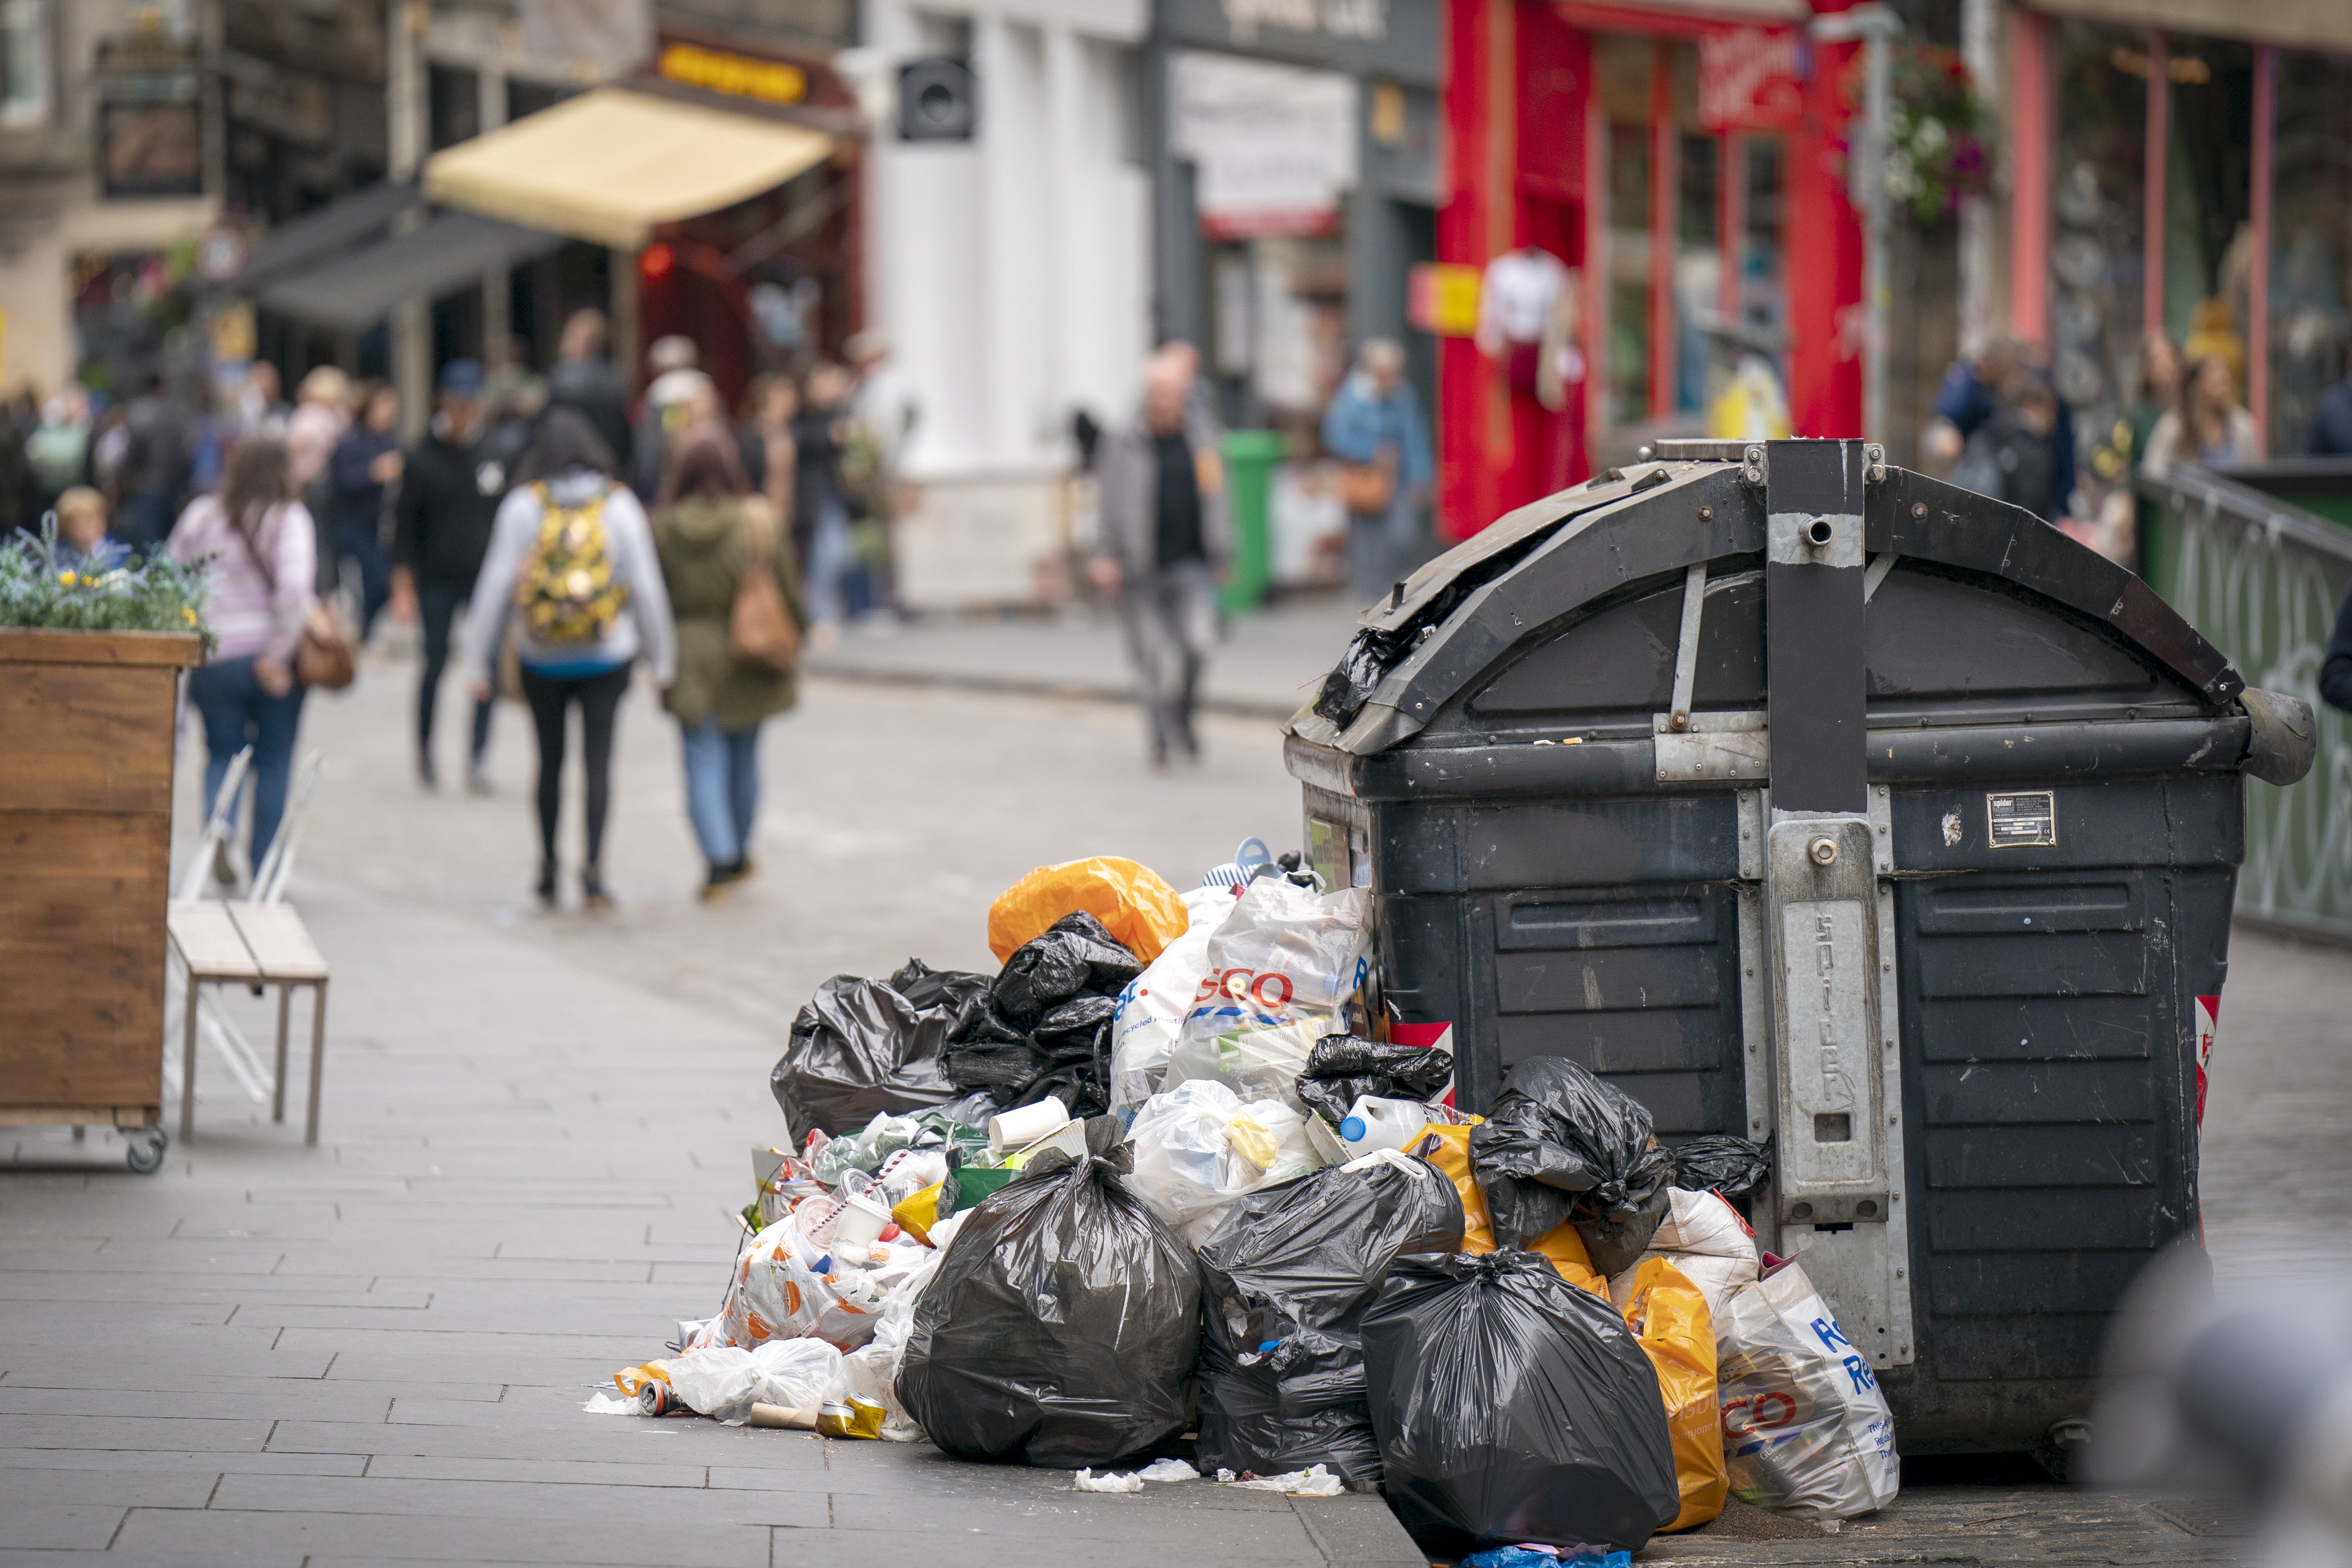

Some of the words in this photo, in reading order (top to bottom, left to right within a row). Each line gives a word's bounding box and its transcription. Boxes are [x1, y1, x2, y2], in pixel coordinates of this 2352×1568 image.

[1994, 799, 2013, 808] spider
[1121, 1015, 1152, 1037] recycled
[1843, 1355, 1881, 1395] Re
[1868, 1421, 1885, 1434] This
[1874, 1434, 1890, 1446] Reuse
